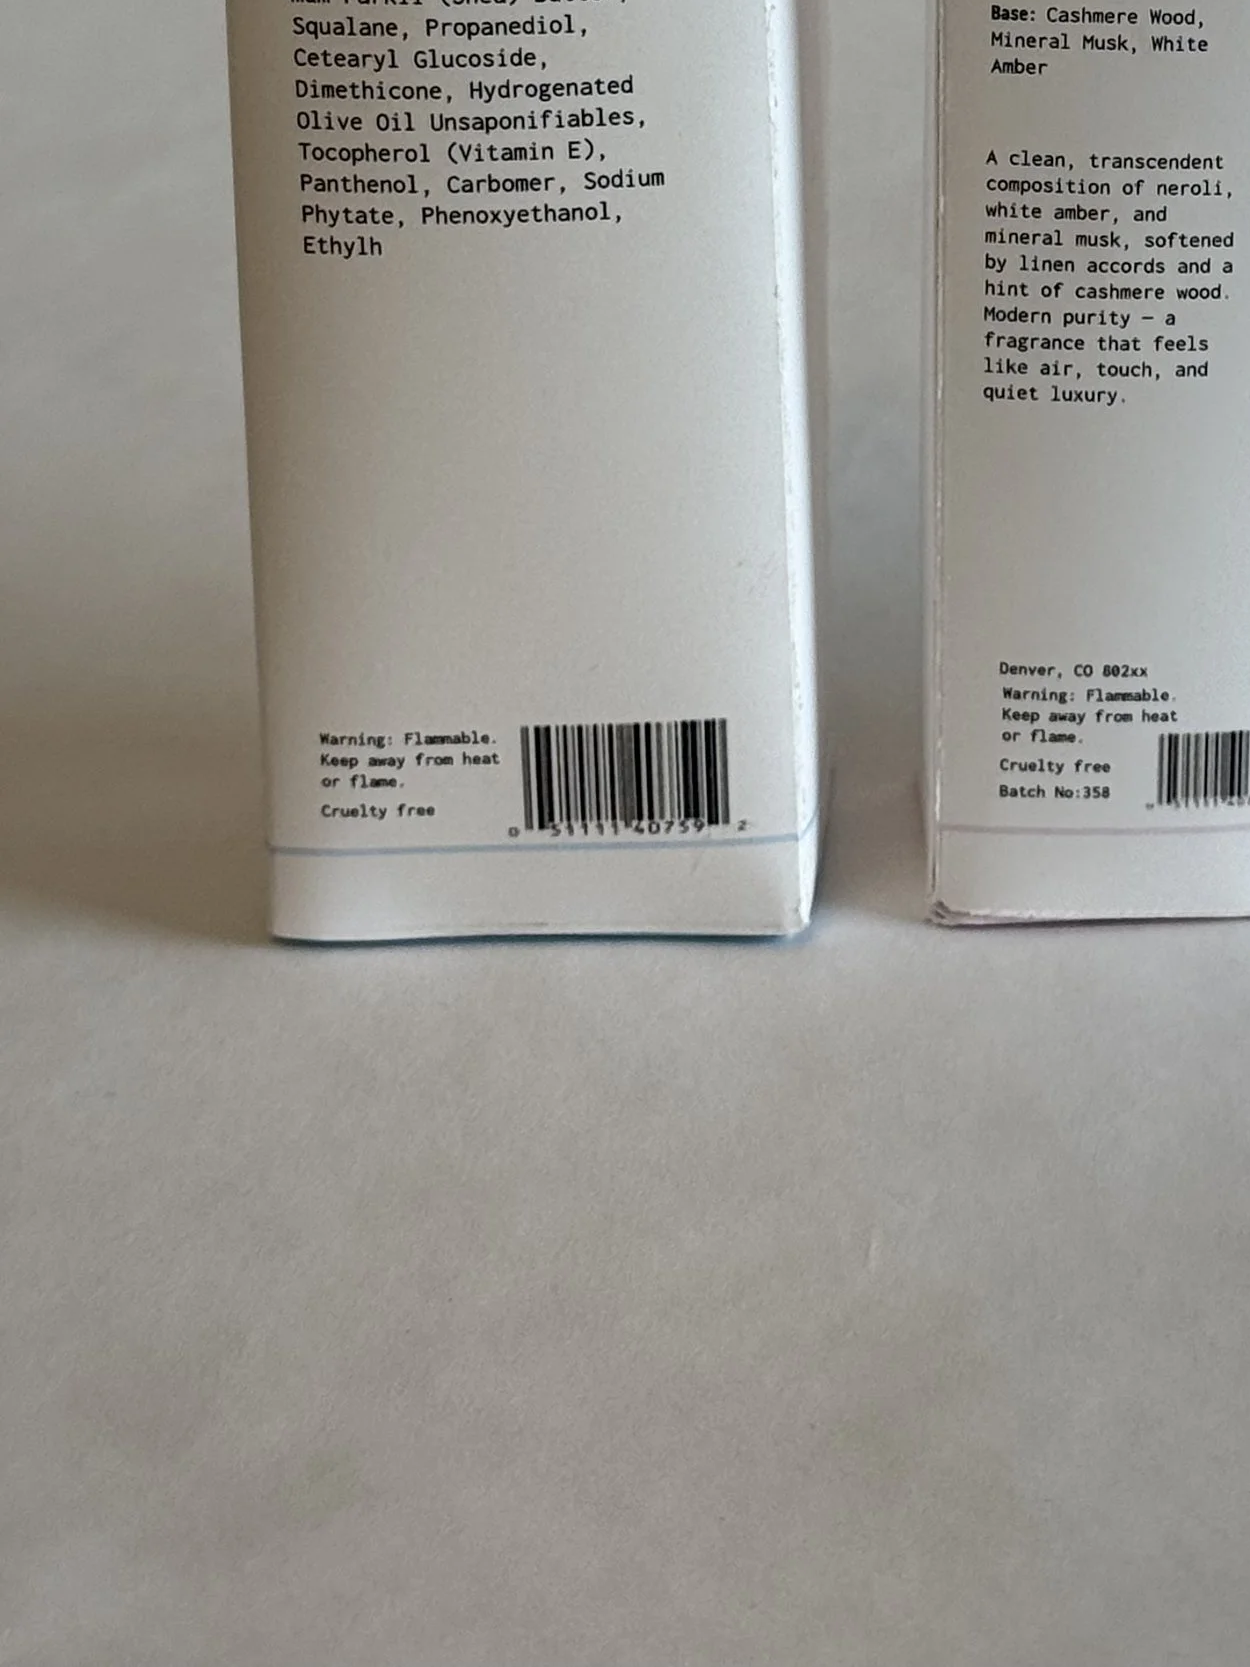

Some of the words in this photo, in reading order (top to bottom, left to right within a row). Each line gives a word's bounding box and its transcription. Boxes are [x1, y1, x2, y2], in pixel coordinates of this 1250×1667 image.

[292, 16, 408, 41] Squalane,
[425, 14, 586, 41] Propanediol,
[991, 5, 1035, 21] Base:
[1047, 7, 1138, 24] Cashmere
[1150, 9, 1203, 29] Wood,
[991, 31, 1070, 49] Mineral
[1082, 34, 1136, 55] Musk,
[1151, 35, 1208, 52] White
[991, 58, 1048, 75] Amber
[295, 79, 452, 104] Dimethicone,
[469, 74, 633, 104] Hydrogenated
[297, 110, 362, 131] Olive
[376, 111, 416, 132] Oil
[430, 107, 645, 135] Unsaponifiables,
[298, 142, 430, 166] Tocopherol
[448, 141, 554, 165] (Vitamin
[568, 138, 605, 162] E),
[985, 150, 998, 166] A
[1009, 150, 1073, 171] clean,
[1089, 153, 1224, 170] transcendent
[300, 174, 430, 198] Panthenol,
[447, 173, 566, 195] Carbomer,
[584, 168, 665, 190] Sodium
[986, 177, 1110, 196] composition
[1122, 179, 1145, 196] of
[1157, 179, 1232, 199] neroli,
[985, 201, 1042, 219] white
[1054, 204, 1118, 225] amber,
[1133, 205, 1167, 222] and
[304, 235, 382, 260] Ethylh
[985, 228, 1063, 246] mineral
[1075, 231, 1129, 251] musk,
[1144, 232, 1234, 248] softened
[985, 253, 1007, 273] by
[1020, 254, 1075, 273] linen
[1087, 257, 1165, 274] accords
[1178, 258, 1211, 274] and
[1222, 261, 1233, 274] a
[985, 279, 1029, 297] hint
[1041, 282, 1064, 298] of
[1075, 283, 1165, 300] cashmere
[1176, 283, 1229, 300] wood.
[984, 306, 1051, 324] Modern
[1063, 310, 1130, 329] purity
[1165, 313, 1176, 326] a
[984, 331, 1085, 353] fragrance
[1097, 335, 1141, 351] that
[1153, 335, 1209, 352] feels
[984, 357, 1028, 375] like
[1040, 360, 1081, 380] air,
[1096, 361, 1160, 381] touch,
[1175, 360, 1208, 377] and
[983, 384, 1039, 402] quiet
[1050, 385, 1125, 406] luxury.
[999, 661, 1062, 679] Denver,
[1073, 664, 1093, 678] CO
[1102, 664, 1148, 678] 802xx
[1003, 687, 1075, 705] Warning:
[1086, 688, 1176, 702] Flammable.
[319, 732, 392, 749] Warning:
[404, 730, 496, 746] Flammable.
[320, 753, 359, 770] Keep
[368, 756, 405, 770] away
[415, 752, 454, 766] from
[462, 751, 500, 766] heat
[320, 777, 340, 788] or
[350, 774, 404, 789] flame.
[999, 784, 1046, 798] Batch
[1054, 786, 1110, 800] No:358
[320, 803, 387, 821] Cruelty
[397, 803, 435, 817] free
